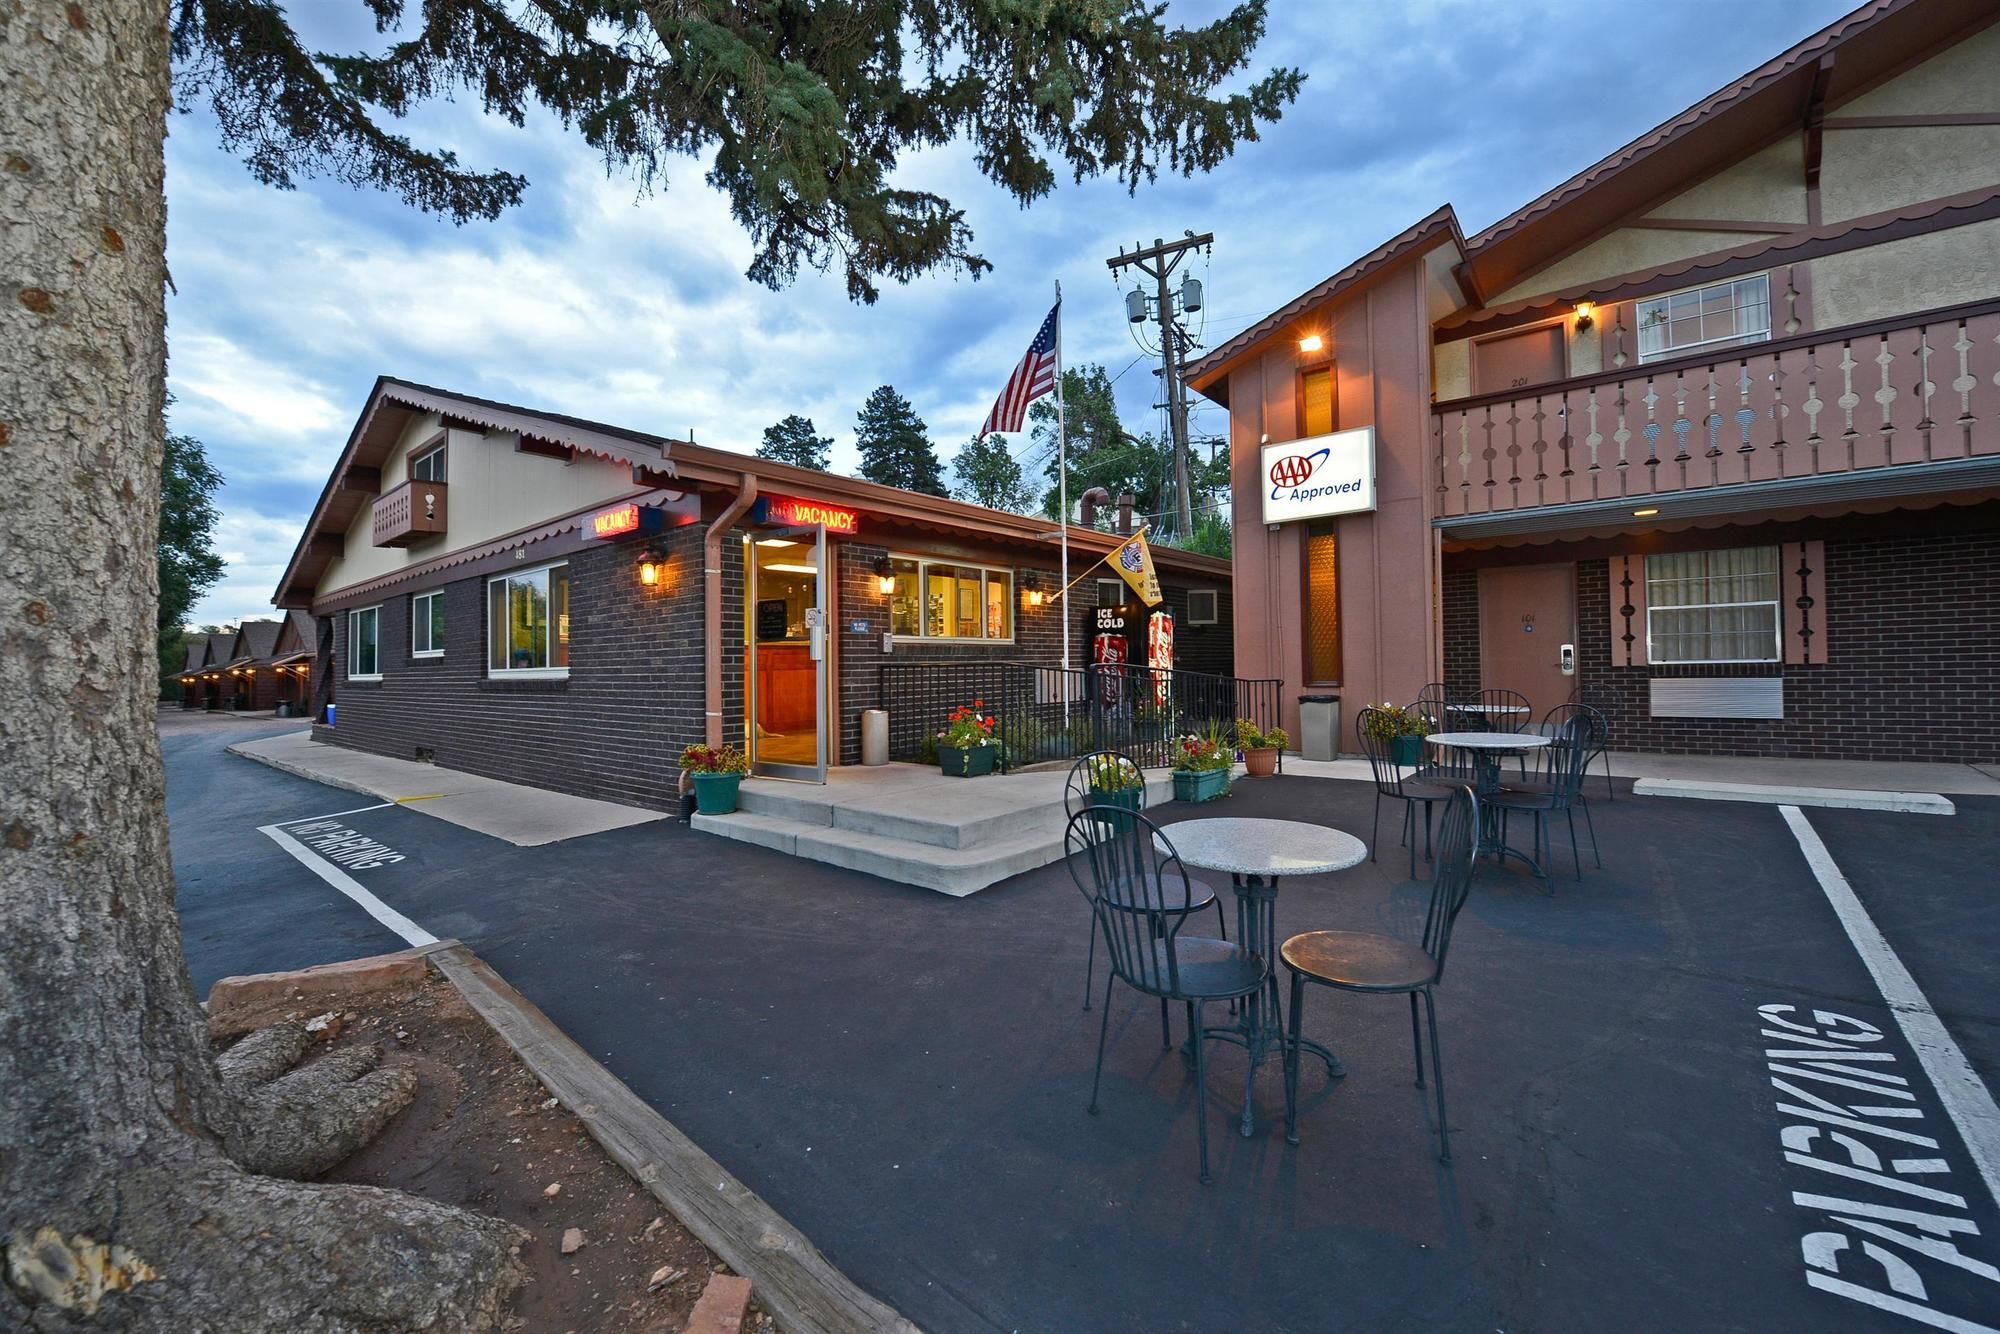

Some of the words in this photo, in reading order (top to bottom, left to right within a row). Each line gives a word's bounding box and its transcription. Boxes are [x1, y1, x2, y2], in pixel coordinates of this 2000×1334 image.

[1511, 376, 1528, 387] 201
[1274, 456, 1309, 487] AAA
[1290, 479, 1362, 502] Approved
[595, 509, 632, 533] VACANCY
[795, 504, 854, 529] VACANCY
[1097, 608, 1113, 619] ICE
[1097, 618, 1125, 629] COLD
[288, 820, 344, 835] NO
[304, 829, 406, 870] PARKING
[1757, 1003, 2000, 1334] PARKING
